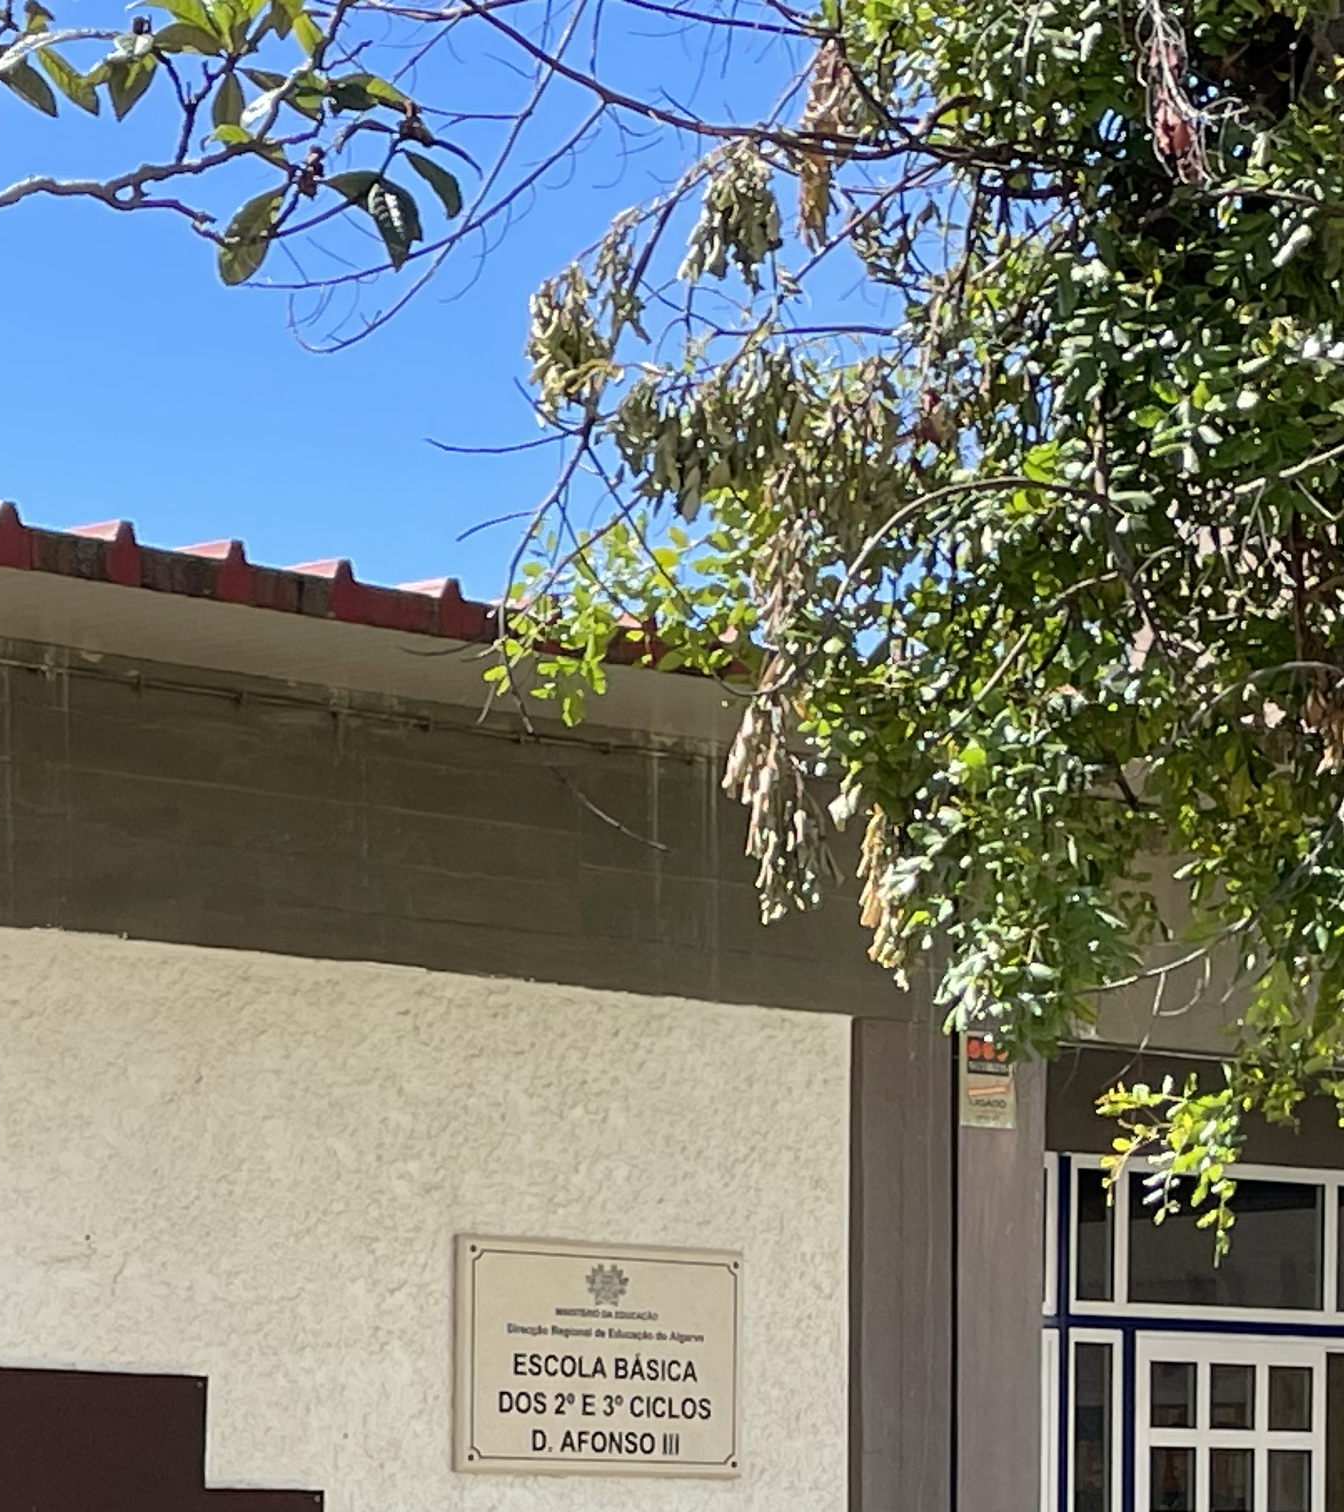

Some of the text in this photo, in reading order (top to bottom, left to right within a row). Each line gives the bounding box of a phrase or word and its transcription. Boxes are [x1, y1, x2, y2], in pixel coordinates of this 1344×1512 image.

[551, 1324, 592, 1339] Regional
[595, 1327, 606, 1339] de
[608, 1327, 653, 1342] Educação
[655, 1330, 667, 1341] do
[669, 1332, 705, 1344] Algarve
[513, 1352, 698, 1383] ESCOLA BÁSICA
[498, 1391, 547, 1415] DOS
[582, 1393, 596, 1417] E
[629, 1396, 712, 1421] CICLOS
[532, 1429, 681, 1456] D. AFONSO III
